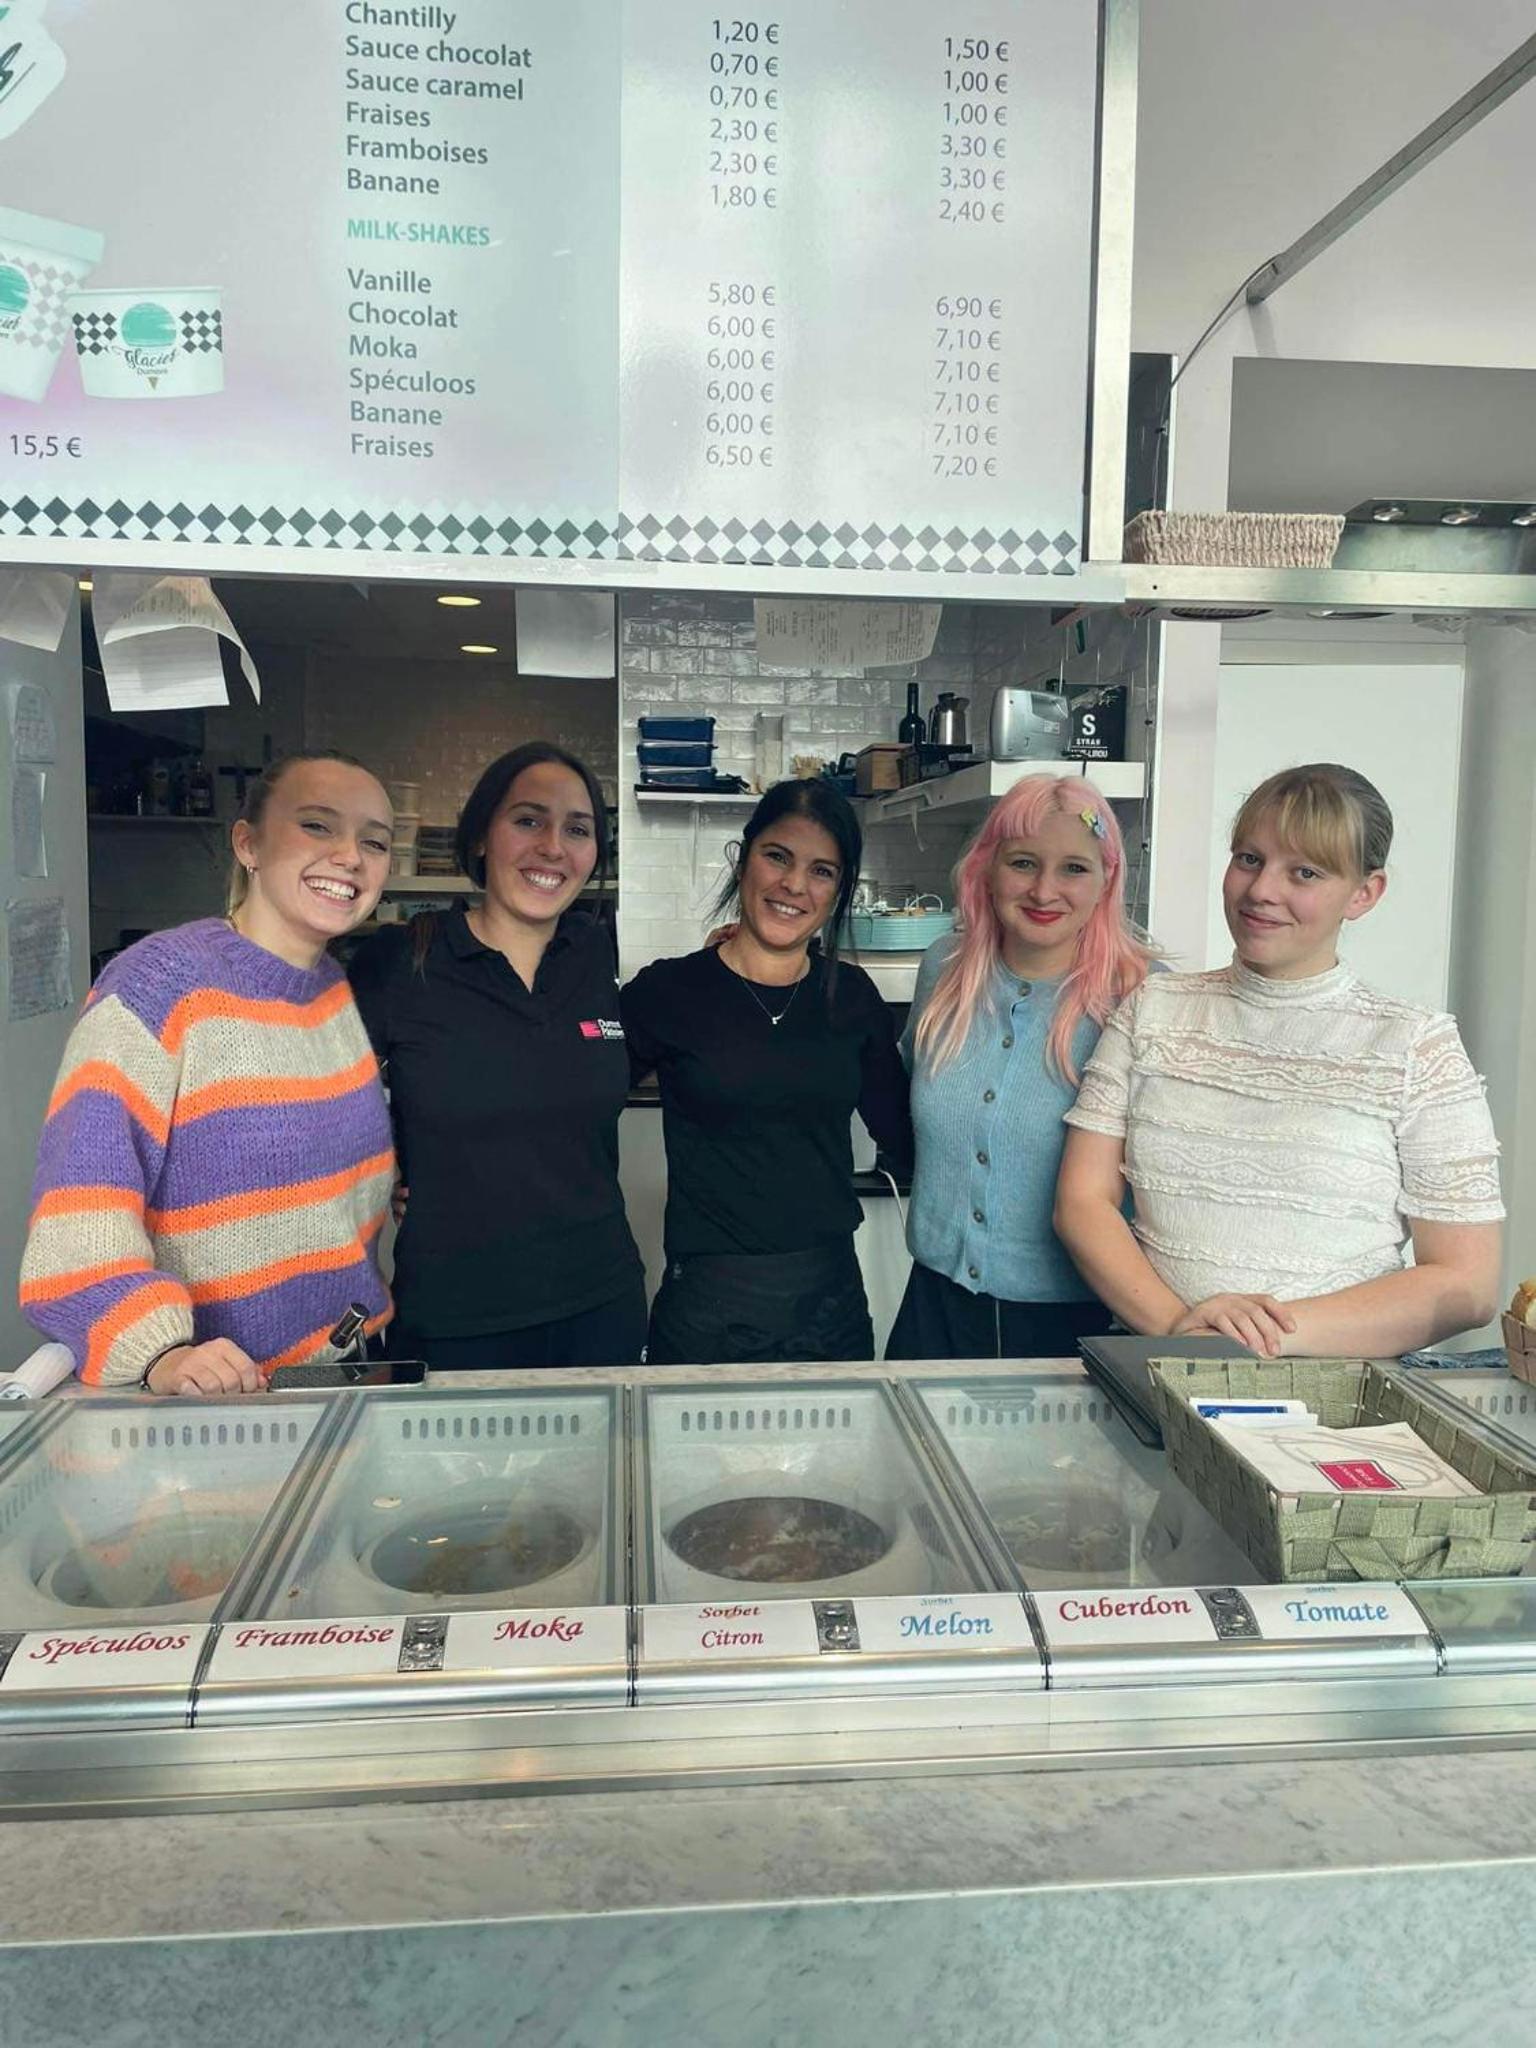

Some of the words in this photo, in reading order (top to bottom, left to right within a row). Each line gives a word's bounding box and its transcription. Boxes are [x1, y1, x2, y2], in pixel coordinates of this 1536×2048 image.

[346, 2, 456, 34] Chantilly
[711, 19, 759, 45] 1,20
[766, 23, 779, 44] €
[346, 35, 418, 60] Sauce
[426, 40, 532, 68] chocolat
[943, 36, 990, 63] 1,50
[996, 41, 1009, 62] €
[709, 51, 759, 77] 0,70
[766, 56, 779, 77] €
[346, 68, 419, 93] Sauce
[426, 76, 523, 100] caramel
[943, 69, 989, 95] 1,00
[996, 73, 1008, 94] €
[709, 84, 758, 110] 0,70
[766, 89, 778, 110] €
[347, 101, 430, 127] Fraises
[943, 101, 988, 127] 1,00
[995, 106, 1007, 126] €
[709, 117, 758, 144] 2,30
[765, 122, 777, 143] €
[347, 135, 488, 164] Framboises
[939, 133, 987, 159] 3,30
[994, 138, 1006, 158] €
[709, 150, 758, 176] 2,30
[765, 155, 777, 176] €
[348, 168, 439, 194] Banane
[939, 165, 987, 191] 3,30
[993, 170, 1005, 191] €
[711, 183, 758, 209] 1,80
[764, 188, 776, 208] €
[938, 198, 986, 224] 2,40
[992, 202, 1004, 223] €
[348, 220, 489, 246] MILK-SHAKES
[347, 268, 431, 294] Vanille
[707, 281, 756, 307] 5,80
[763, 286, 775, 306] €
[349, 302, 458, 328] Chocolat
[935, 295, 983, 320] 6,90
[990, 299, 1001, 319] €
[707, 314, 755, 339] 6,00
[762, 318, 775, 339] €
[935, 327, 982, 352] 7,10
[988, 331, 1000, 351] €
[350, 335, 417, 359] Moka
[706, 347, 755, 372] 6,00
[762, 351, 774, 371] €
[350, 368, 475, 395] Spéculoos
[934, 359, 981, 384] 7,10
[988, 363, 1000, 383] €
[706, 379, 755, 404] 6,00
[761, 383, 774, 403] €
[933, 390, 980, 416] 7,10
[987, 394, 999, 414] €
[351, 401, 442, 426] Banane
[705, 411, 754, 437] 6,00
[761, 415, 773, 435] €
[10, 434, 59, 459] 15,5
[66, 437, 82, 458] €
[351, 433, 433, 458] Fraises
[933, 422, 980, 447] 7,10
[985, 426, 997, 446] €
[705, 444, 754, 468] 6,50
[760, 447, 772, 467] €
[932, 454, 978, 479] 7,20
[984, 457, 996, 477] €
[1082, 714, 1096, 736] S
[698, 1605, 761, 1620] Sorbet
[1059, 1594, 1192, 1622] Cuberdon
[1284, 1599, 1389, 1622] Tomate
[235, 1624, 394, 1648] Framboise
[493, 1615, 584, 1642] Moka
[900, 1611, 993, 1638] Melon
[29, 1631, 191, 1665] Spéculoos
[700, 1629, 764, 1649] Citron
